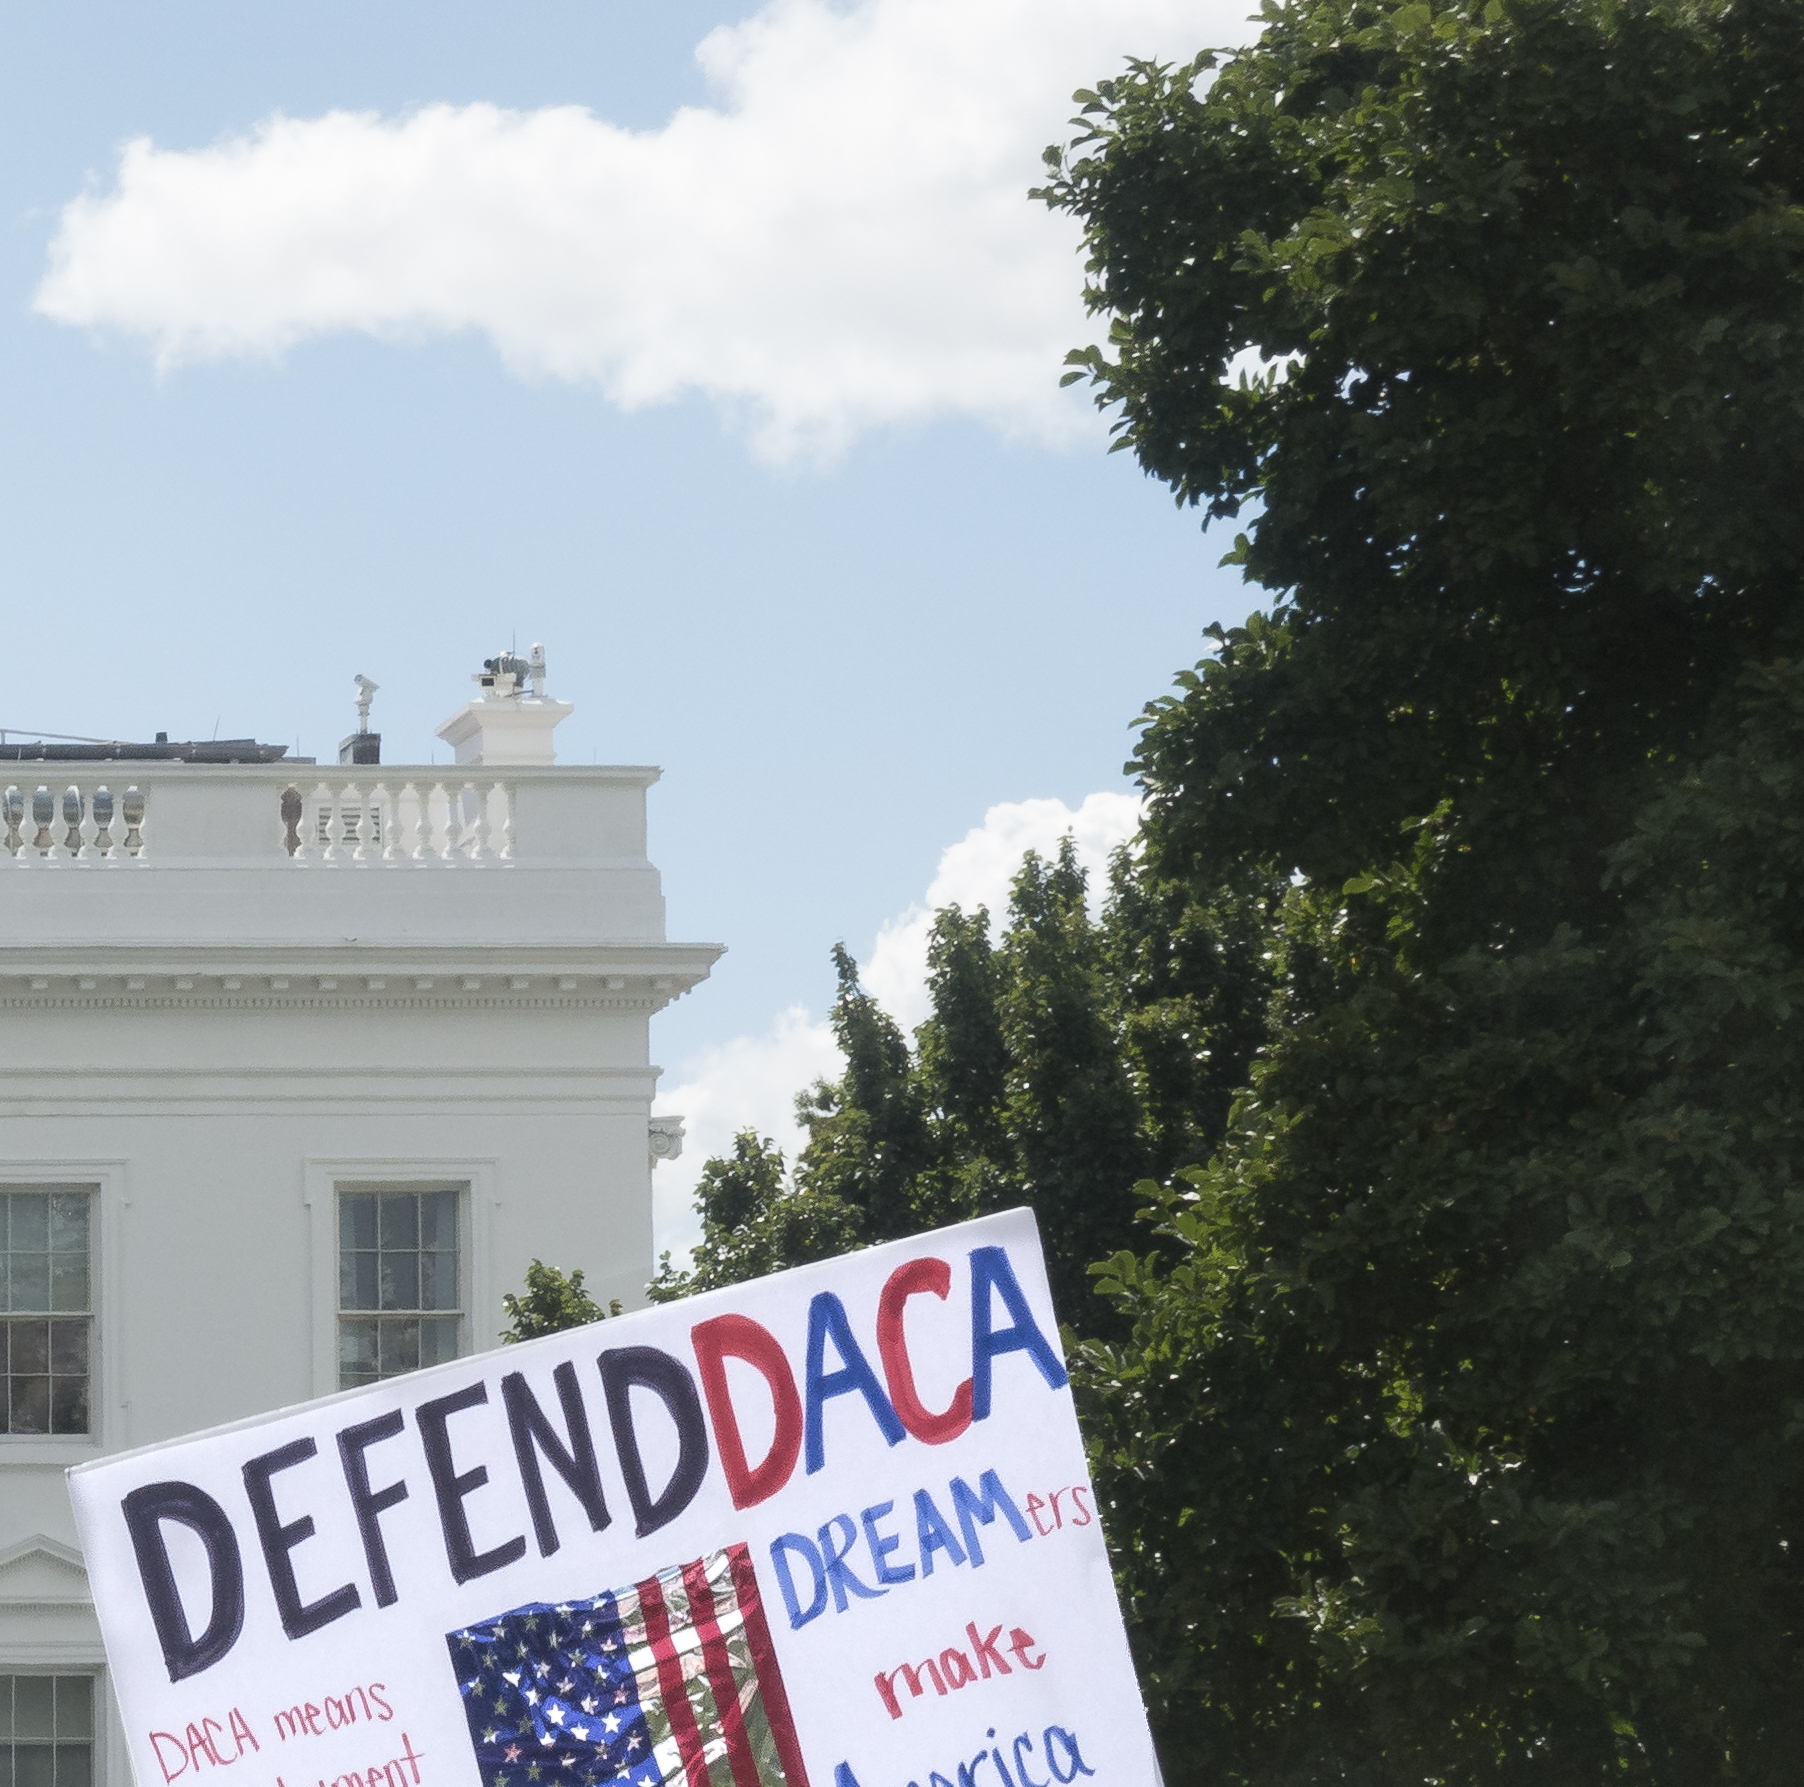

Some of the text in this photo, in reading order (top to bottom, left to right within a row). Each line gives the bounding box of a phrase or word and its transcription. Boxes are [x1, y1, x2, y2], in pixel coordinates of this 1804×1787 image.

[769, 1468, 1092, 1630] DREAMers
[874, 1622, 1047, 1721] make
[149, 1682, 394, 1785] DACA means
